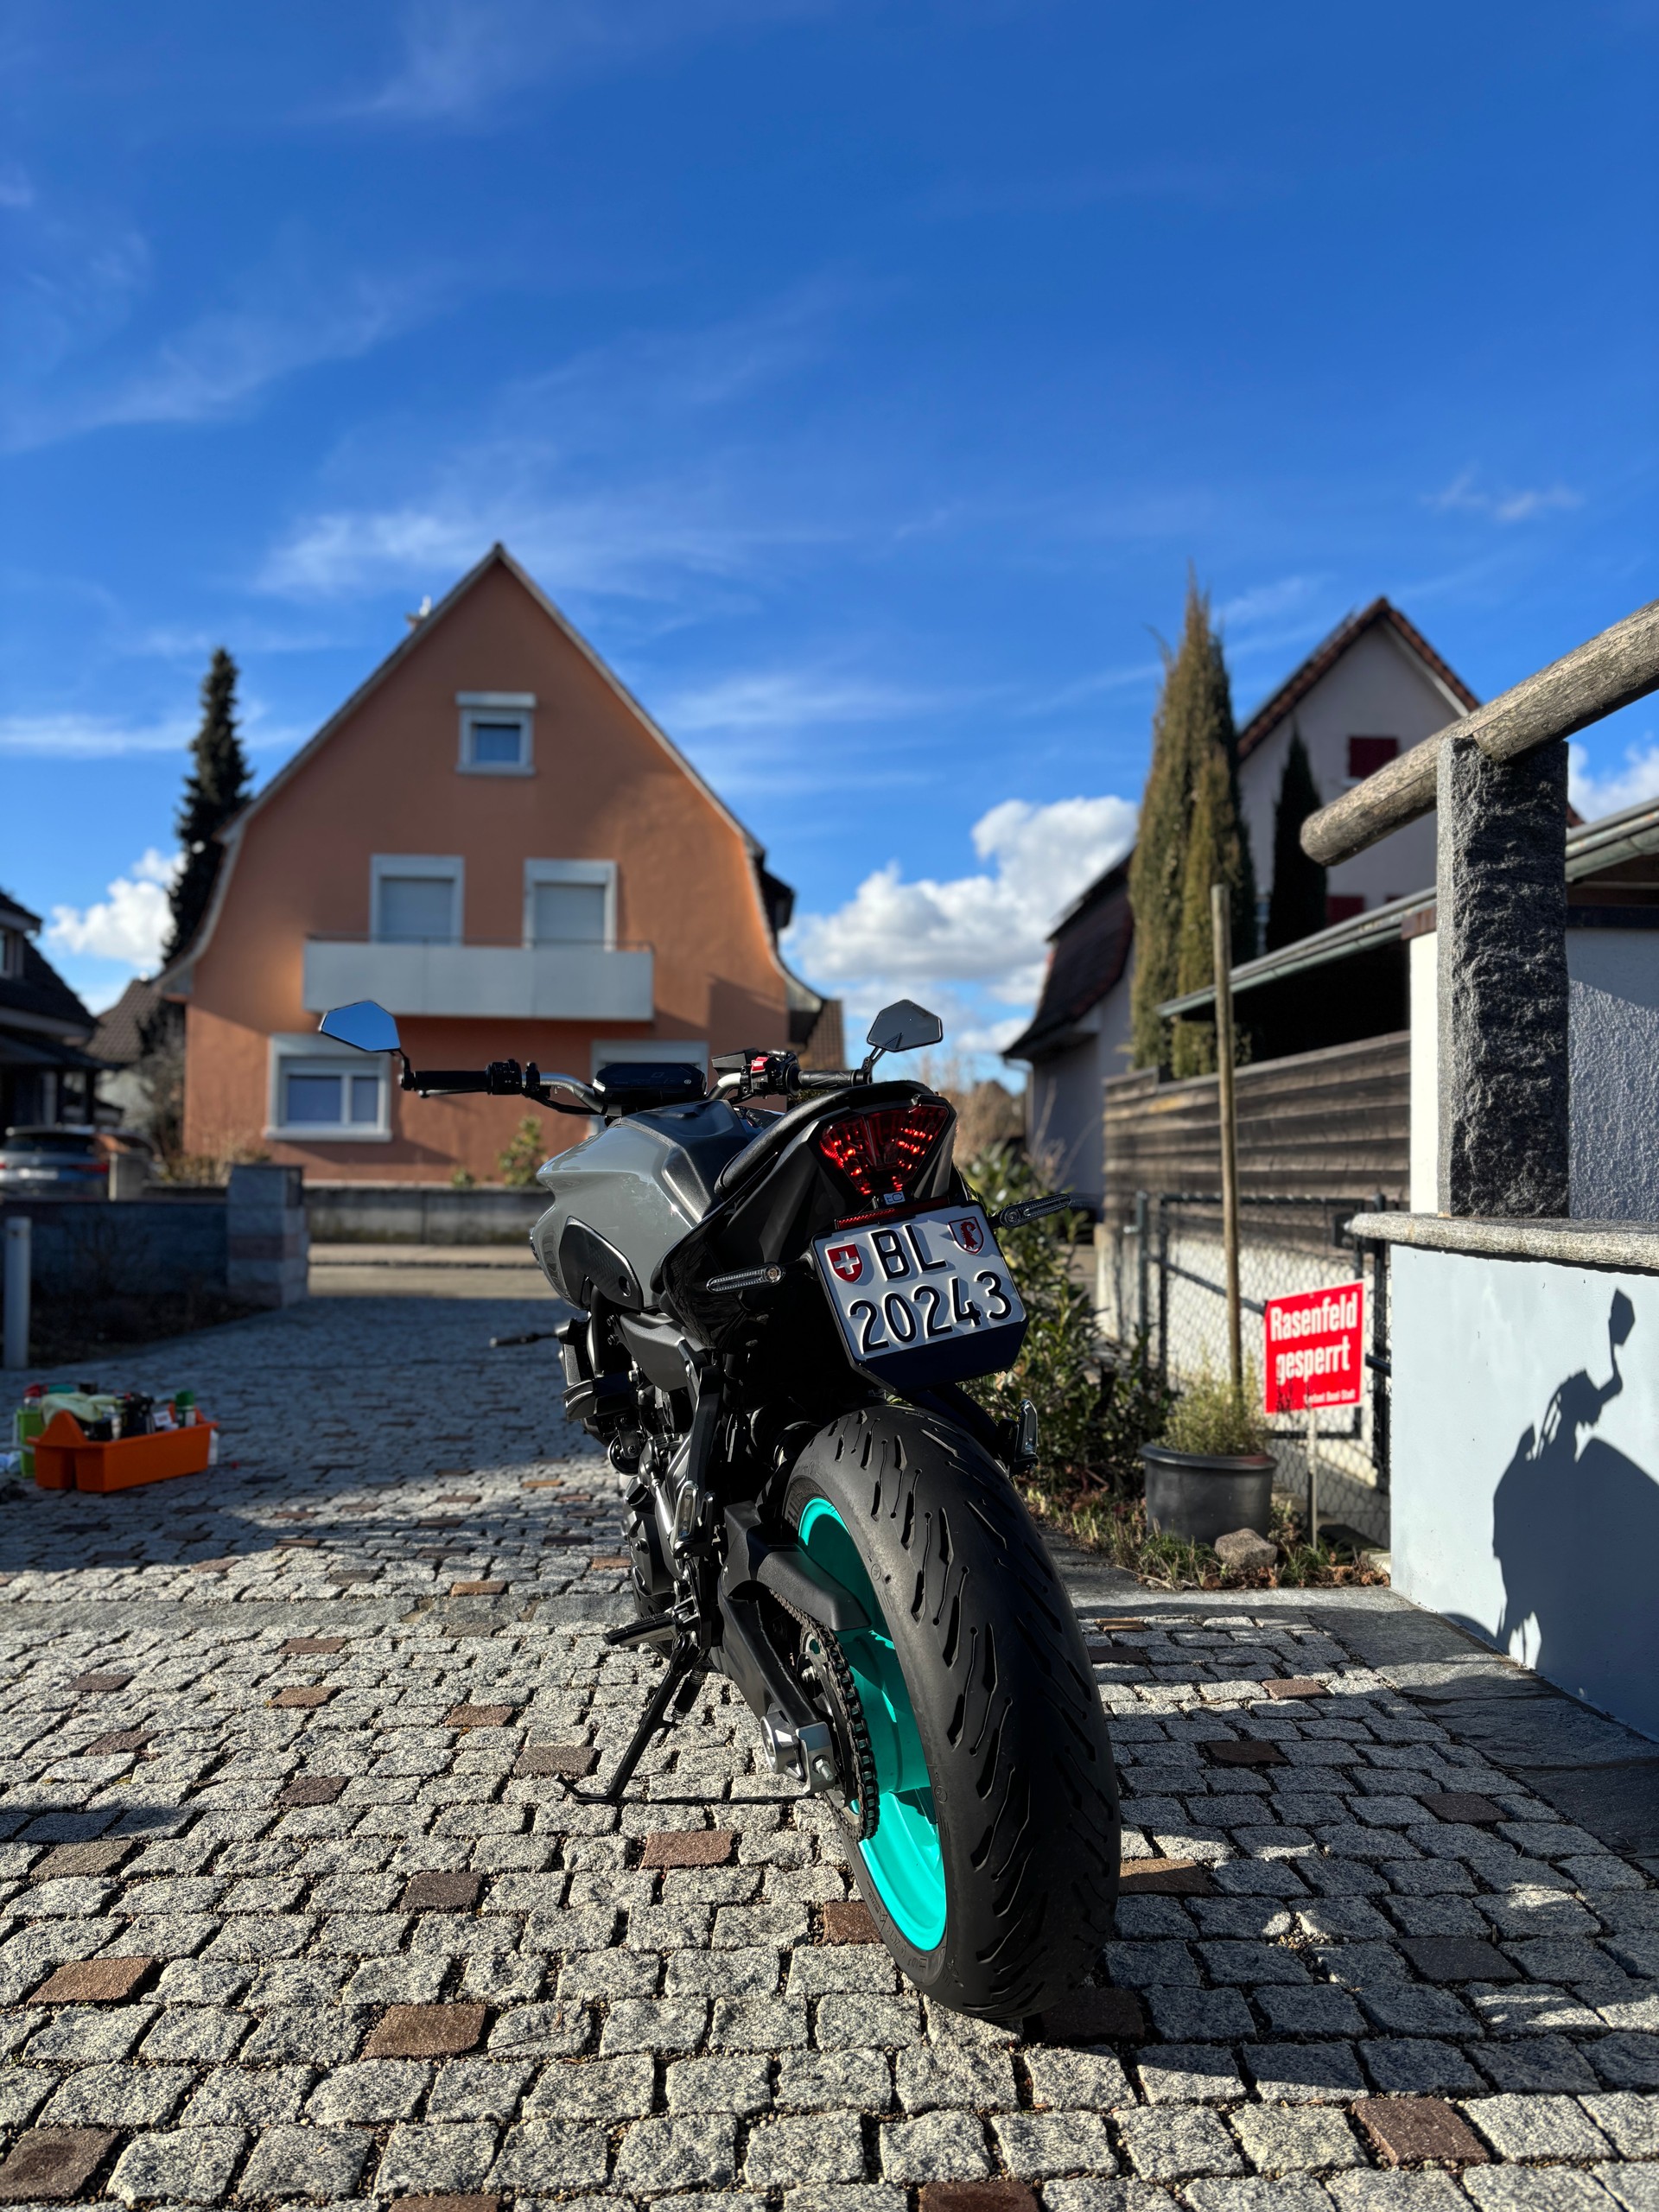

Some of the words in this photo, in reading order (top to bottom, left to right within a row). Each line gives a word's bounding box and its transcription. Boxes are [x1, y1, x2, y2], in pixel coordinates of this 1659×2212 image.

[868, 1223, 947, 1281] BL
[849, 1270, 1012, 1354] 20243
[1270, 1292, 1357, 1342] Rasenfeld
[1276, 1335, 1351, 1386] gesperrt
